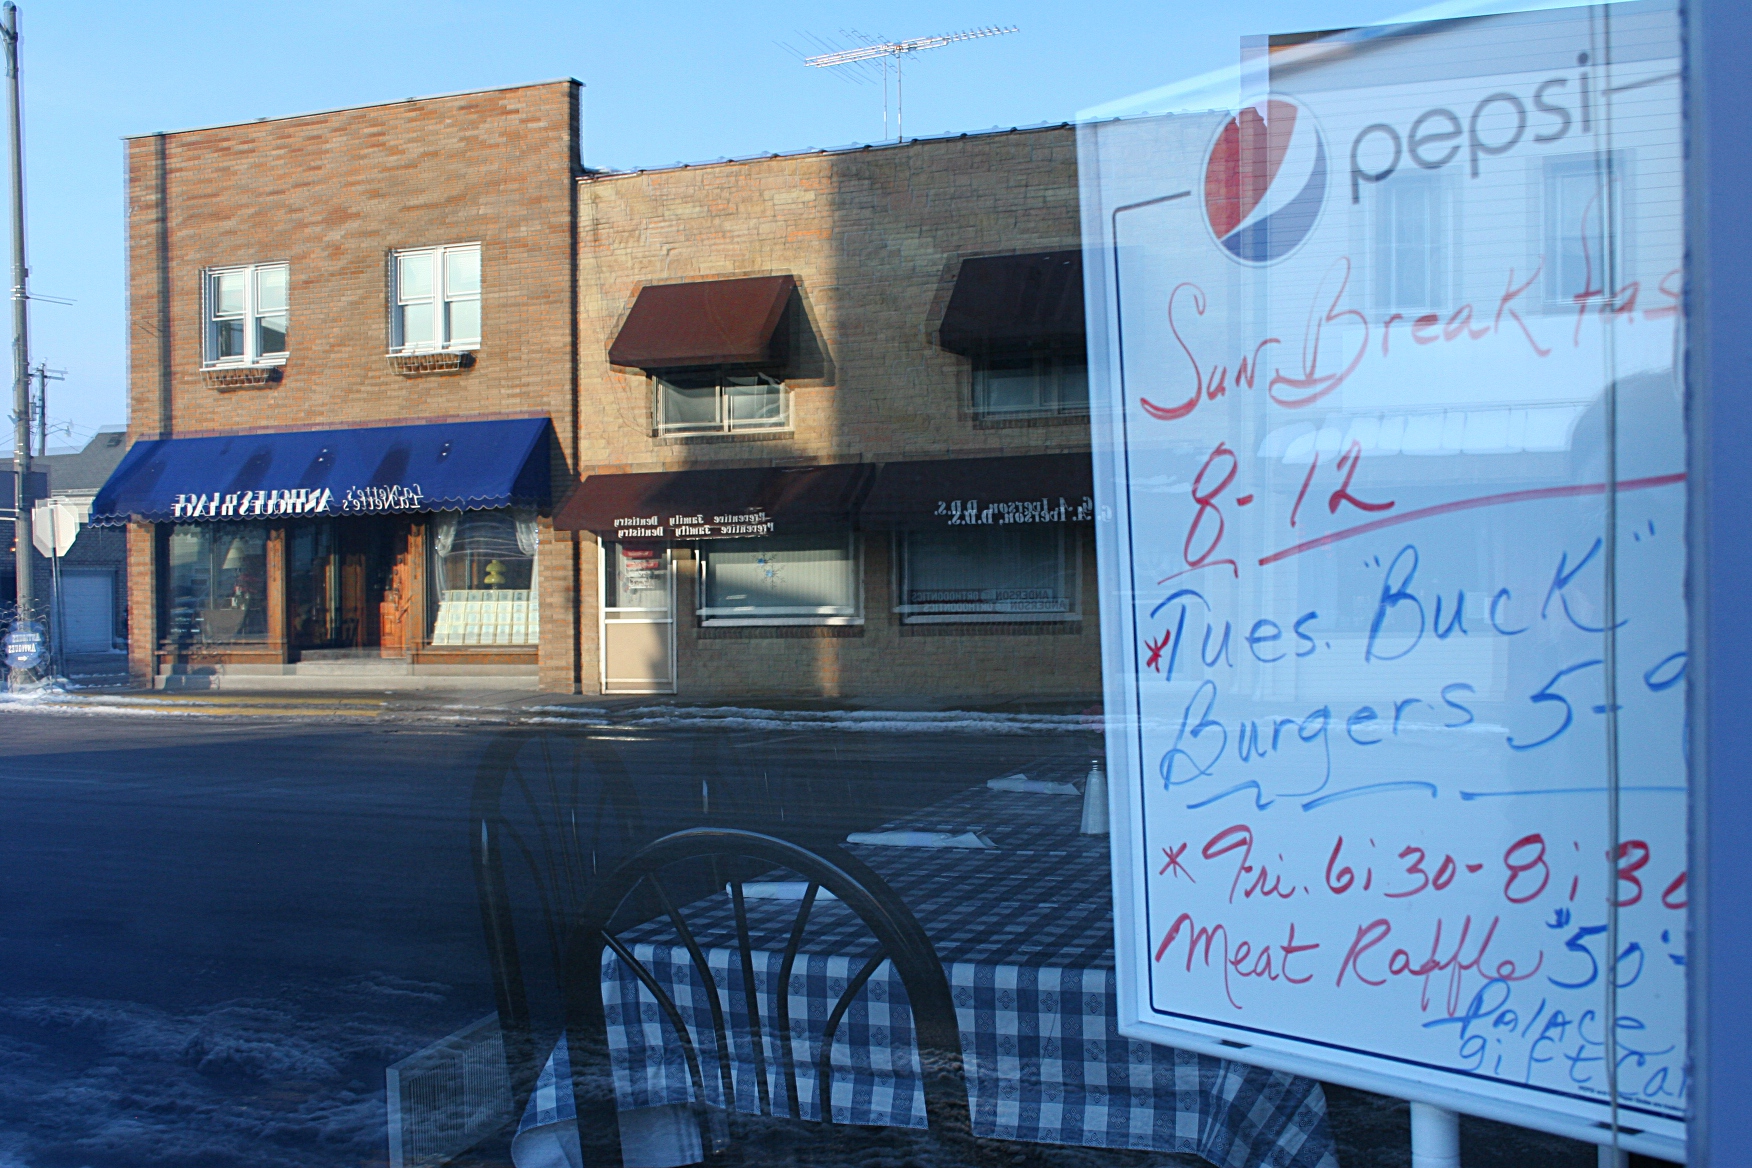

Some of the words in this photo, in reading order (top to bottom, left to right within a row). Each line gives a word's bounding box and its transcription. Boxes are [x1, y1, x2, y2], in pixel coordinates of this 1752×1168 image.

[1350, 51, 1592, 205] pepsi
[1160, 680, 1476, 797] Burgers
[1155, 912, 1320, 1010] Meat
[1336, 915, 1544, 1018] Raffle
